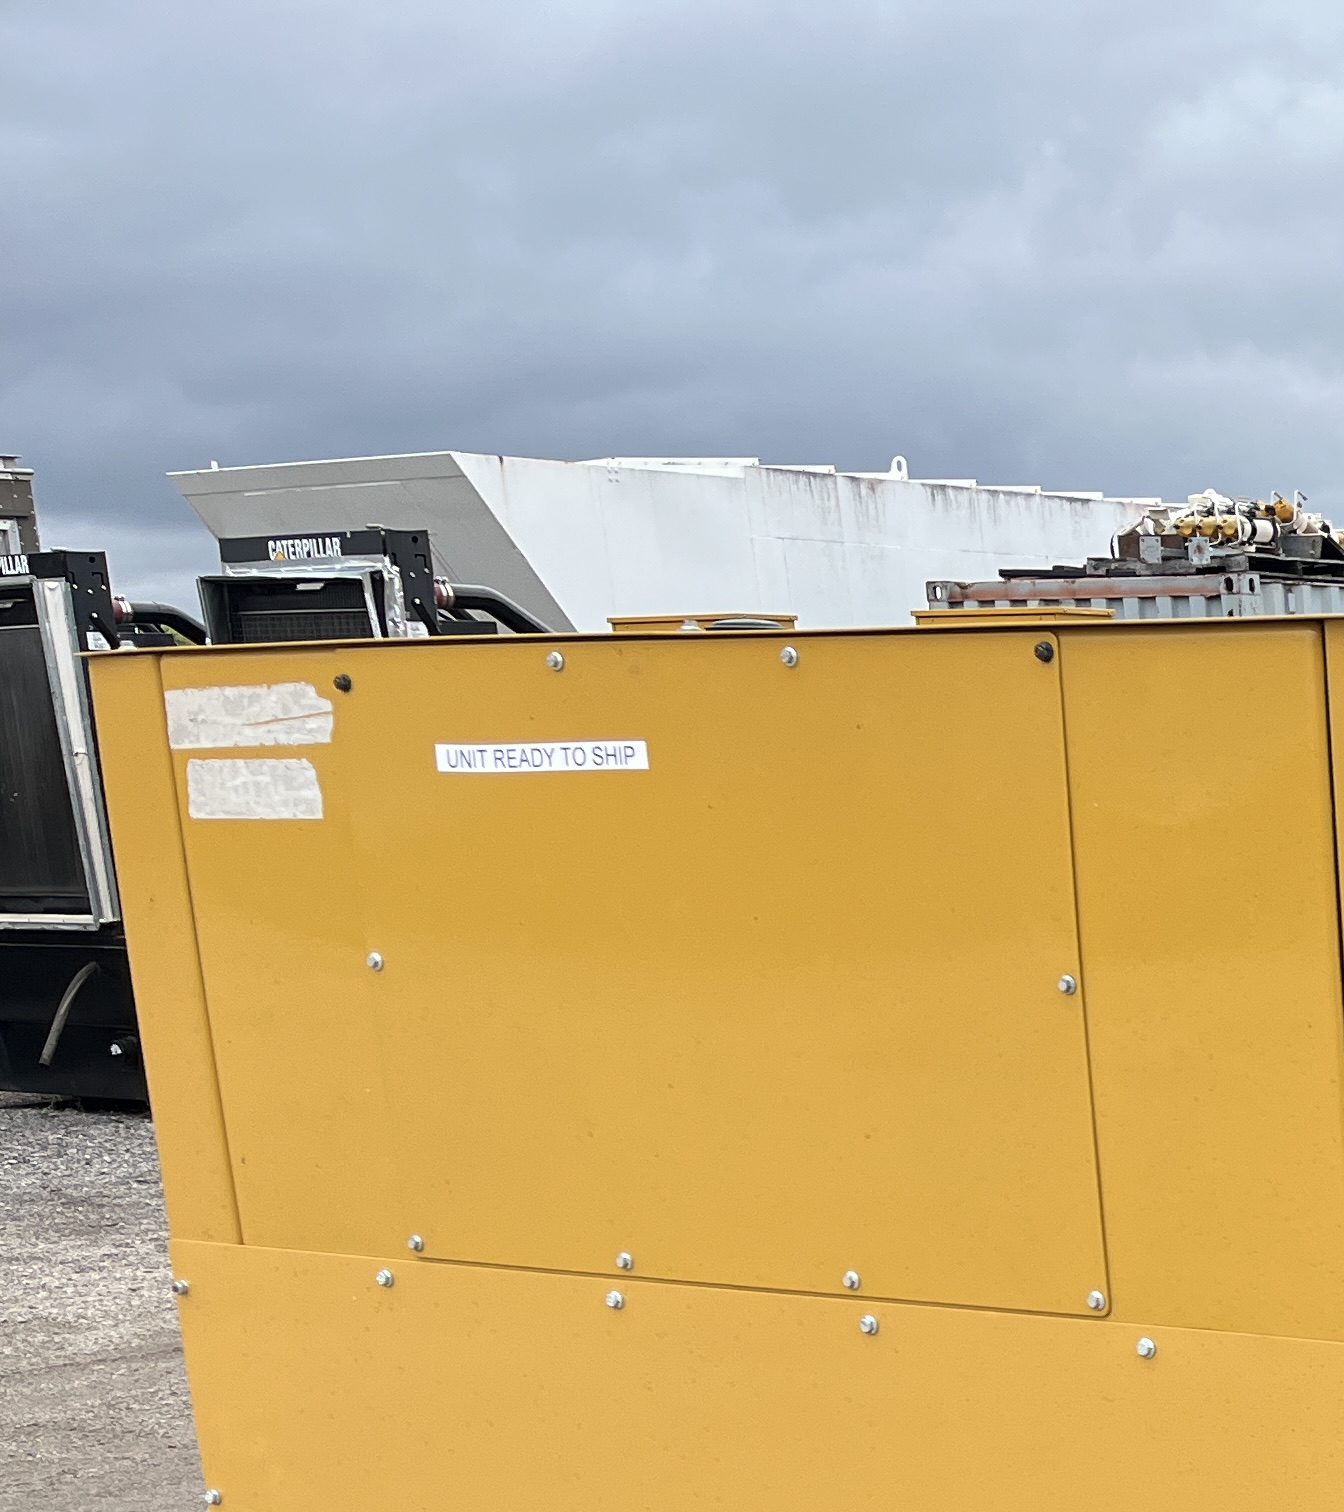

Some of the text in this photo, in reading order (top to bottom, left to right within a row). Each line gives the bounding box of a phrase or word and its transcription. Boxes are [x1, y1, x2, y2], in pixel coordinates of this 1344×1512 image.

[267, 537, 342, 561] CATERPILLAR
[446, 745, 636, 769] UNIT READY TO SHIP
